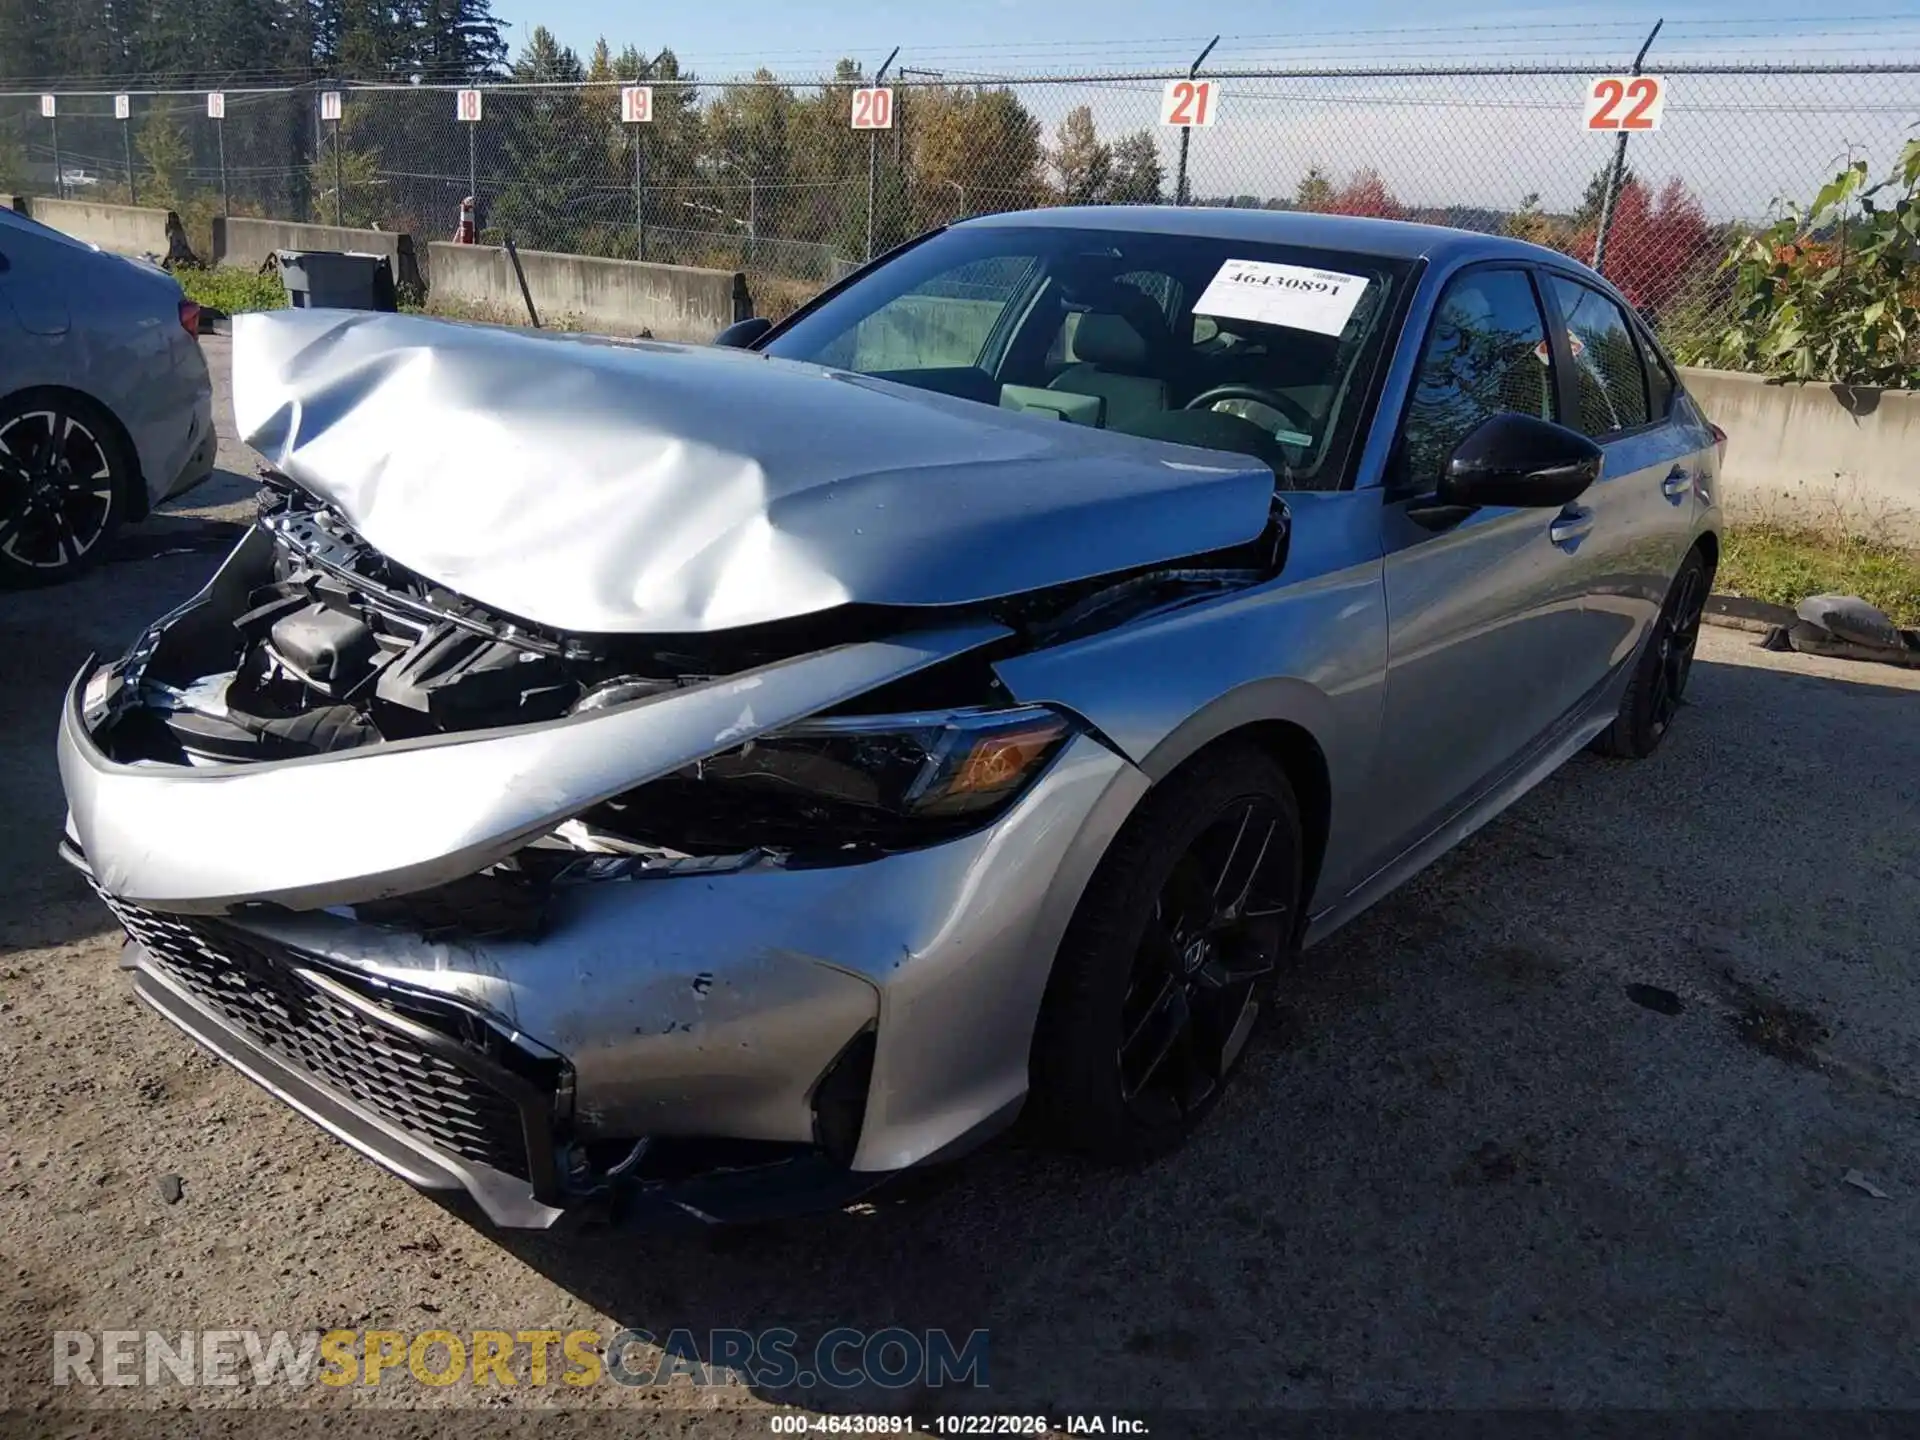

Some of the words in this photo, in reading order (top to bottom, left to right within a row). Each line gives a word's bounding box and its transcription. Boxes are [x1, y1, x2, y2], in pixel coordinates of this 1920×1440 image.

[211, 95, 221, 116] 16
[460, 91, 477, 118] 18
[626, 88, 648, 120] 19
[855, 89, 889, 127] 20
[1169, 82, 1209, 124] 21
[1589, 78, 1658, 128] 22
[1229, 272, 1340, 296] 46430891
